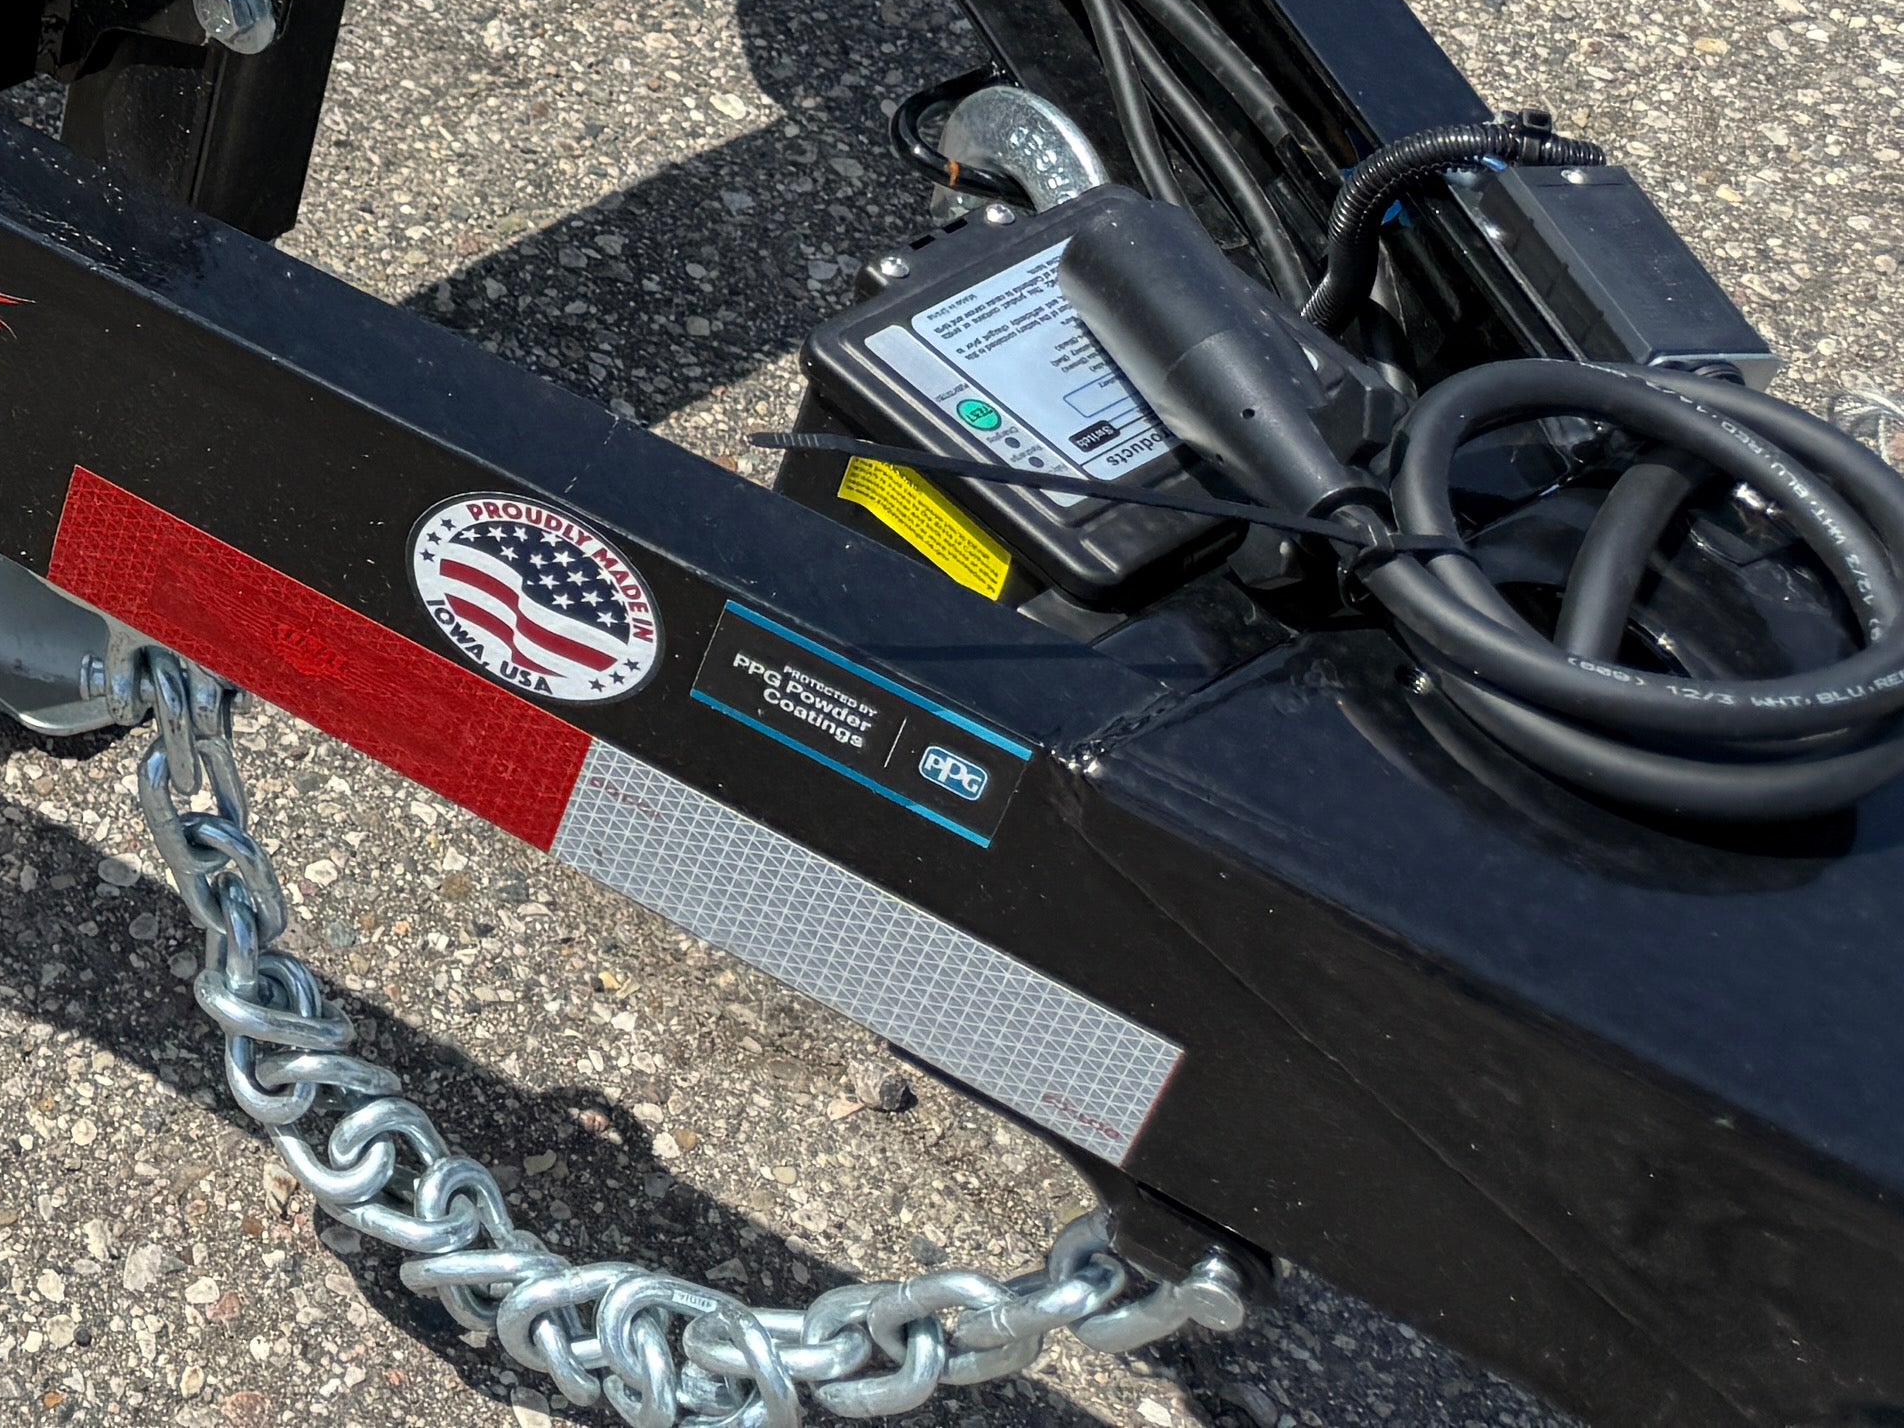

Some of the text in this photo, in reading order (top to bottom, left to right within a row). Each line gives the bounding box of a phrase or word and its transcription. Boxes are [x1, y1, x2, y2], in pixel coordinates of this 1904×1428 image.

[1075, 424, 1114, 448] Switch
[1103, 426, 1176, 469] roducts
[465, 501, 654, 643] PROUDLY MADE IN
[426, 599, 554, 696] IOWA, USA
[731, 653, 873, 733] PPG Powder
[758, 686, 867, 750] Coatings
[781, 665, 877, 718] PROTECTED BY
[1665, 684, 1735, 705] 12/3
[921, 749, 984, 796] PPG
